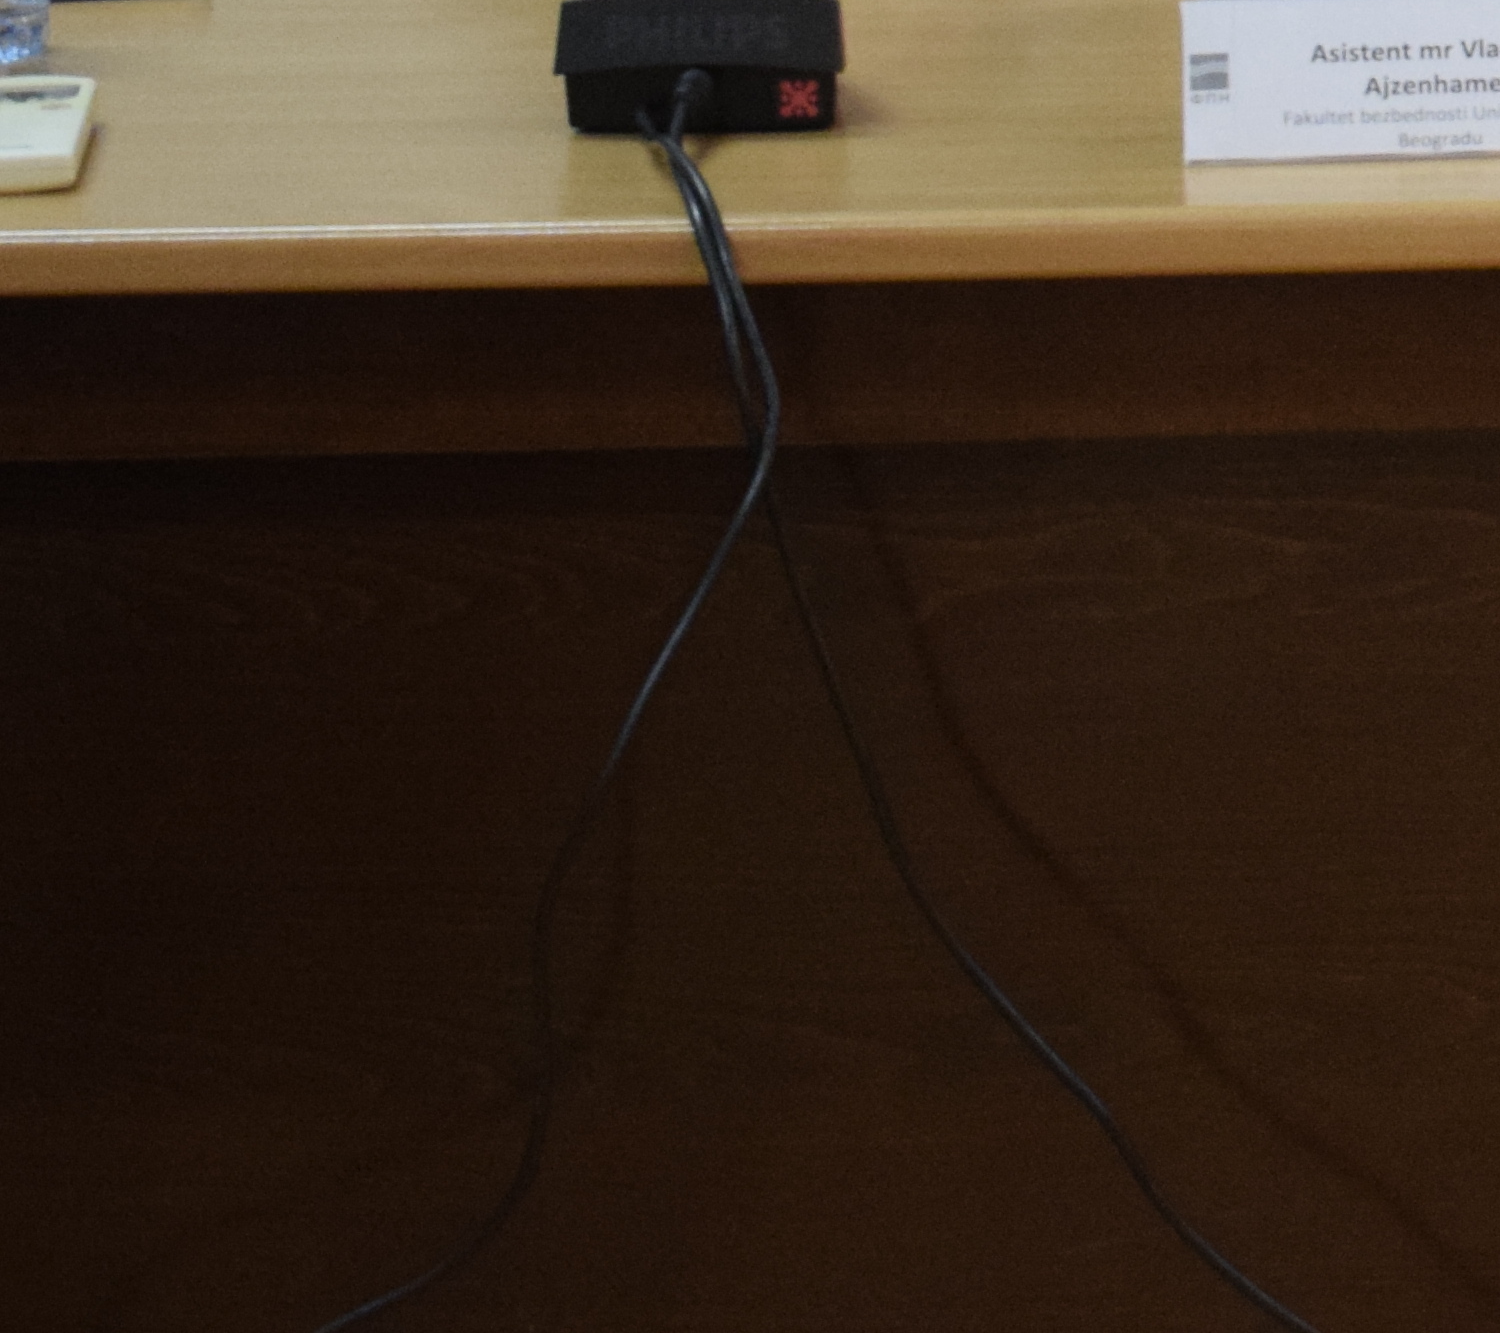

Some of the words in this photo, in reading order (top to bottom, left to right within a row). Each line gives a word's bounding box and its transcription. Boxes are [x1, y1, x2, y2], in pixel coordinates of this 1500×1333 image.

[1311, 42, 1411, 64] Asistent
[1419, 45, 1453, 60] mr
[1282, 108, 1355, 126] Fakultet
[1360, 107, 1467, 125] bezbednosti
[1399, 130, 1483, 150] Beogradu
